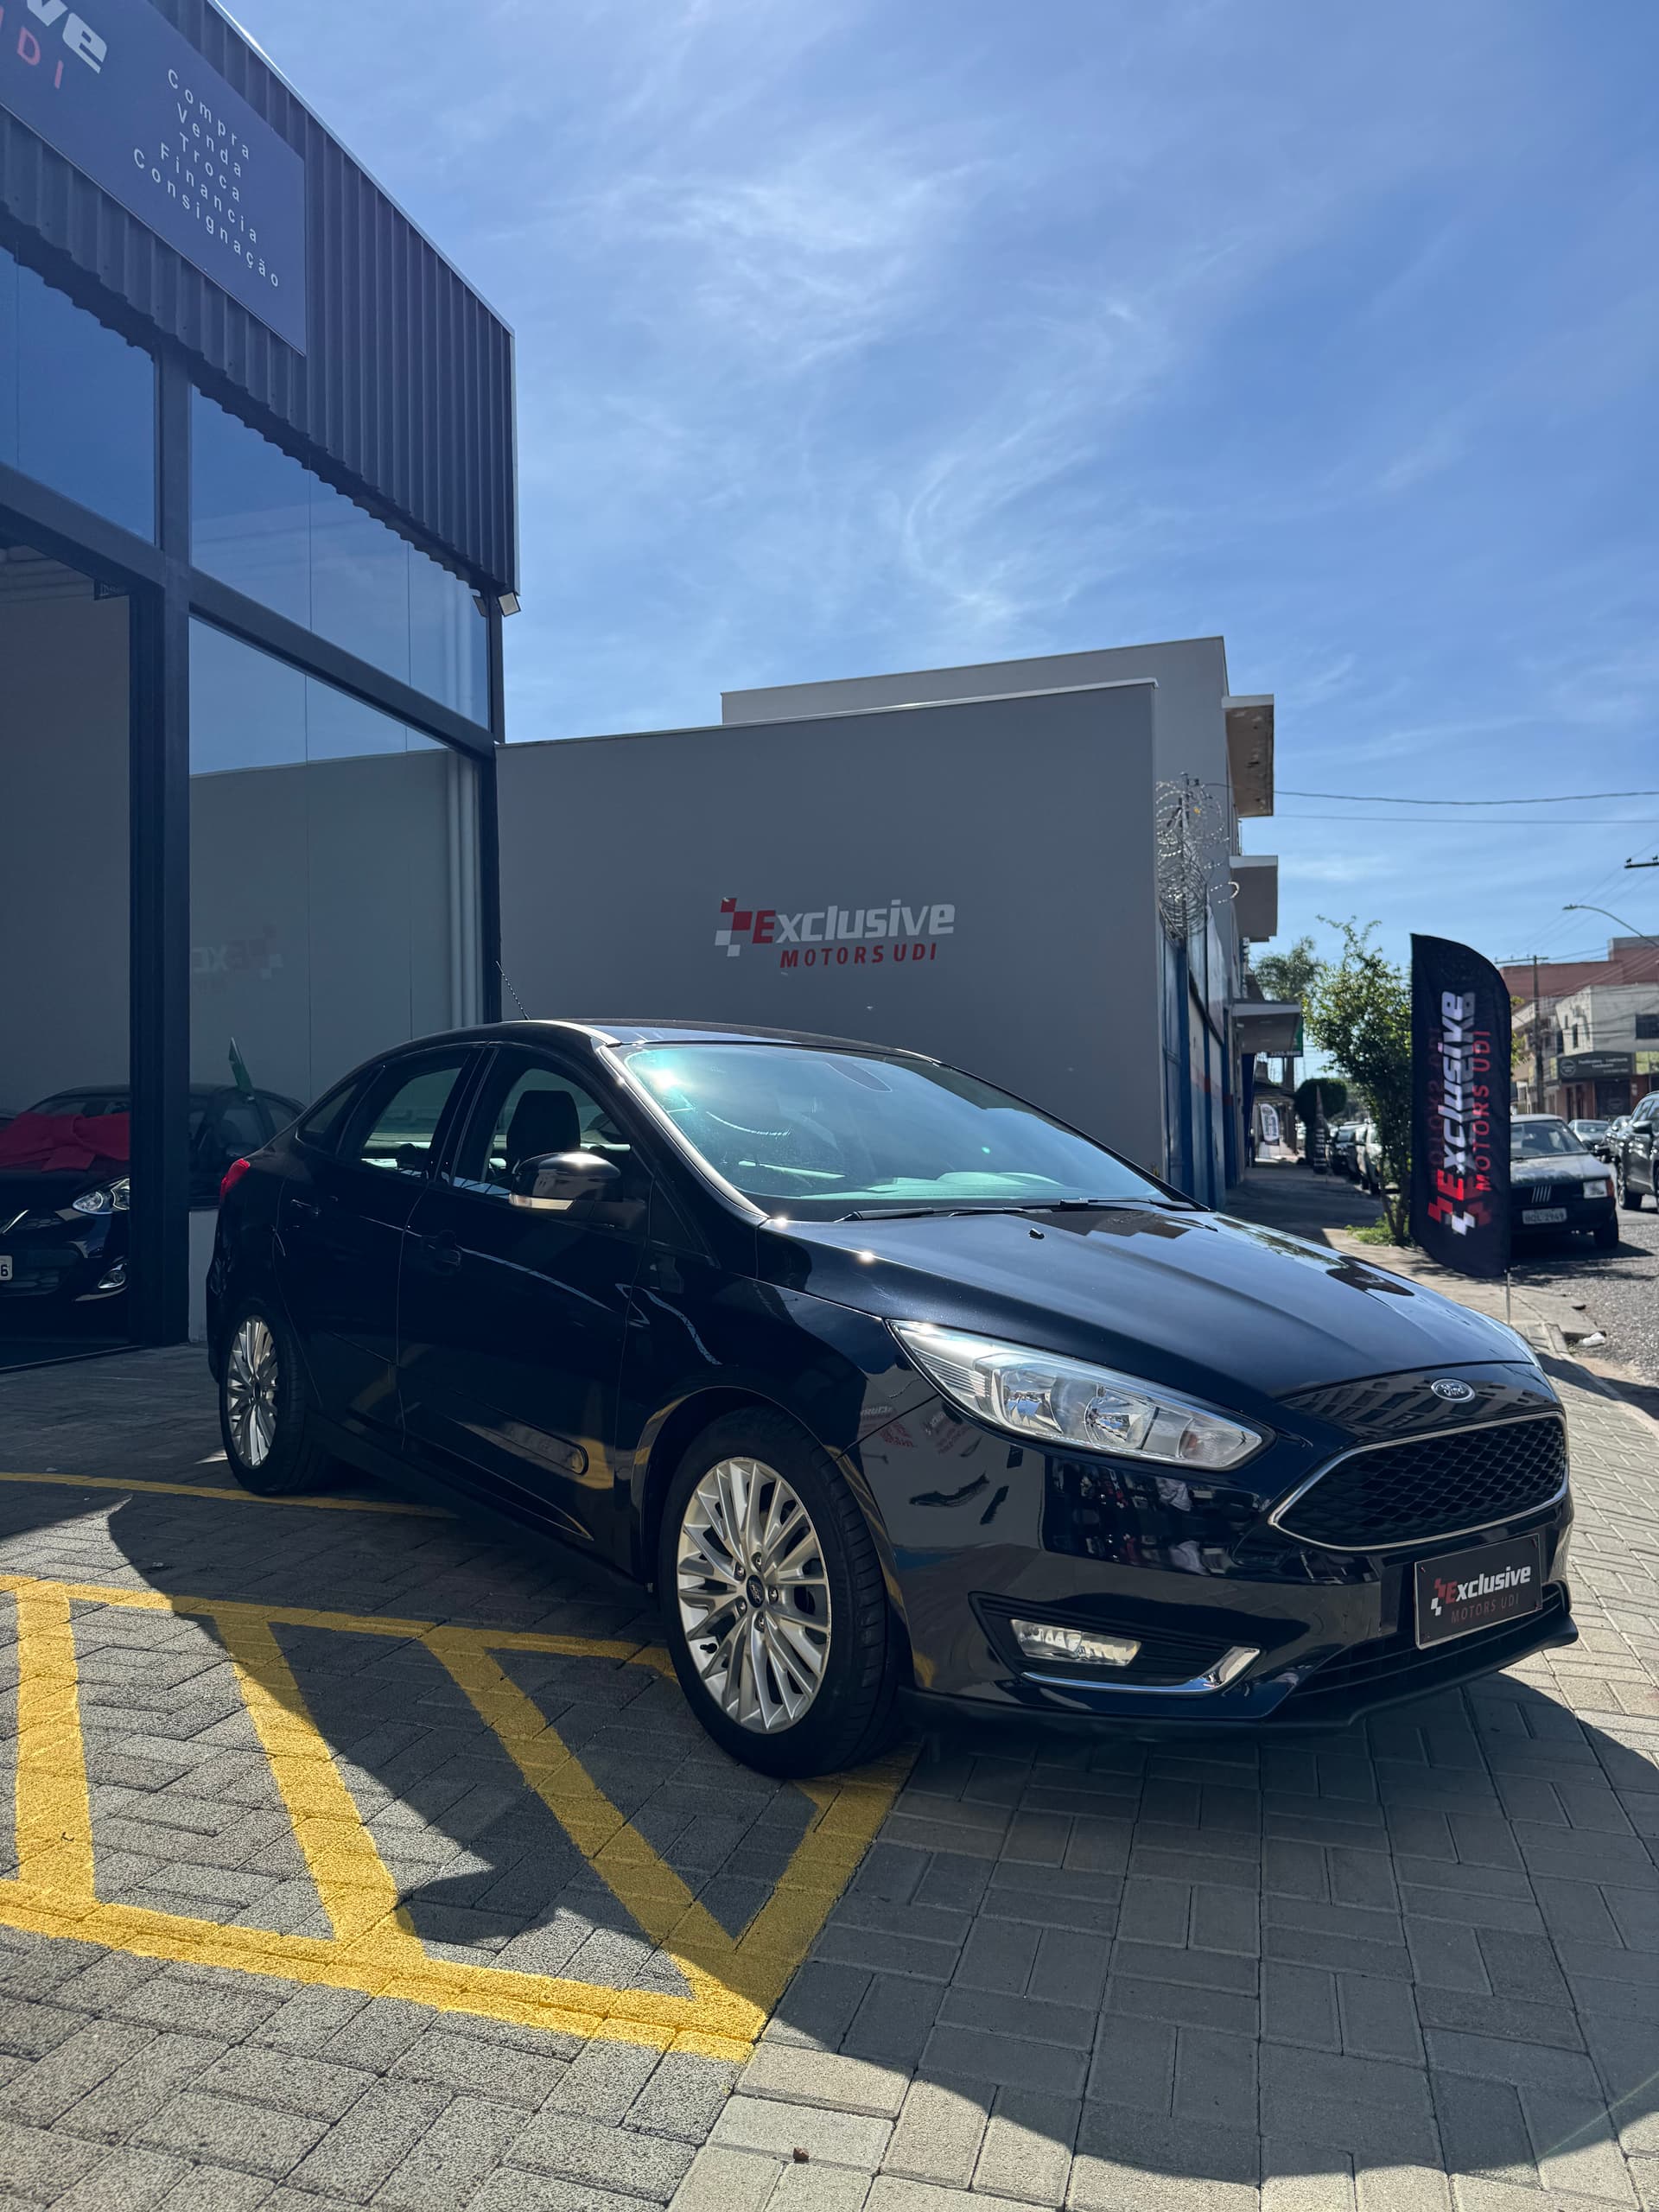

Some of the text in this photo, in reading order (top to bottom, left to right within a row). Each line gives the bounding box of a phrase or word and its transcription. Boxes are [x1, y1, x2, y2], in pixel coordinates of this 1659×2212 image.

[168, 69, 249, 159] Compra
[177, 102, 241, 178] Venda
[161, 143, 257, 243] Financia
[179, 132, 240, 202] Troca
[134, 148, 279, 287] Consignação
[752, 899, 956, 944] Exclusive
[779, 943, 938, 969] MOTORS UDI
[1471, 1030, 1492, 1192] MOTORS UDI
[1446, 1566, 1532, 1605] Exclusive
[1451, 1592, 1520, 1624] MOTORS UDI
